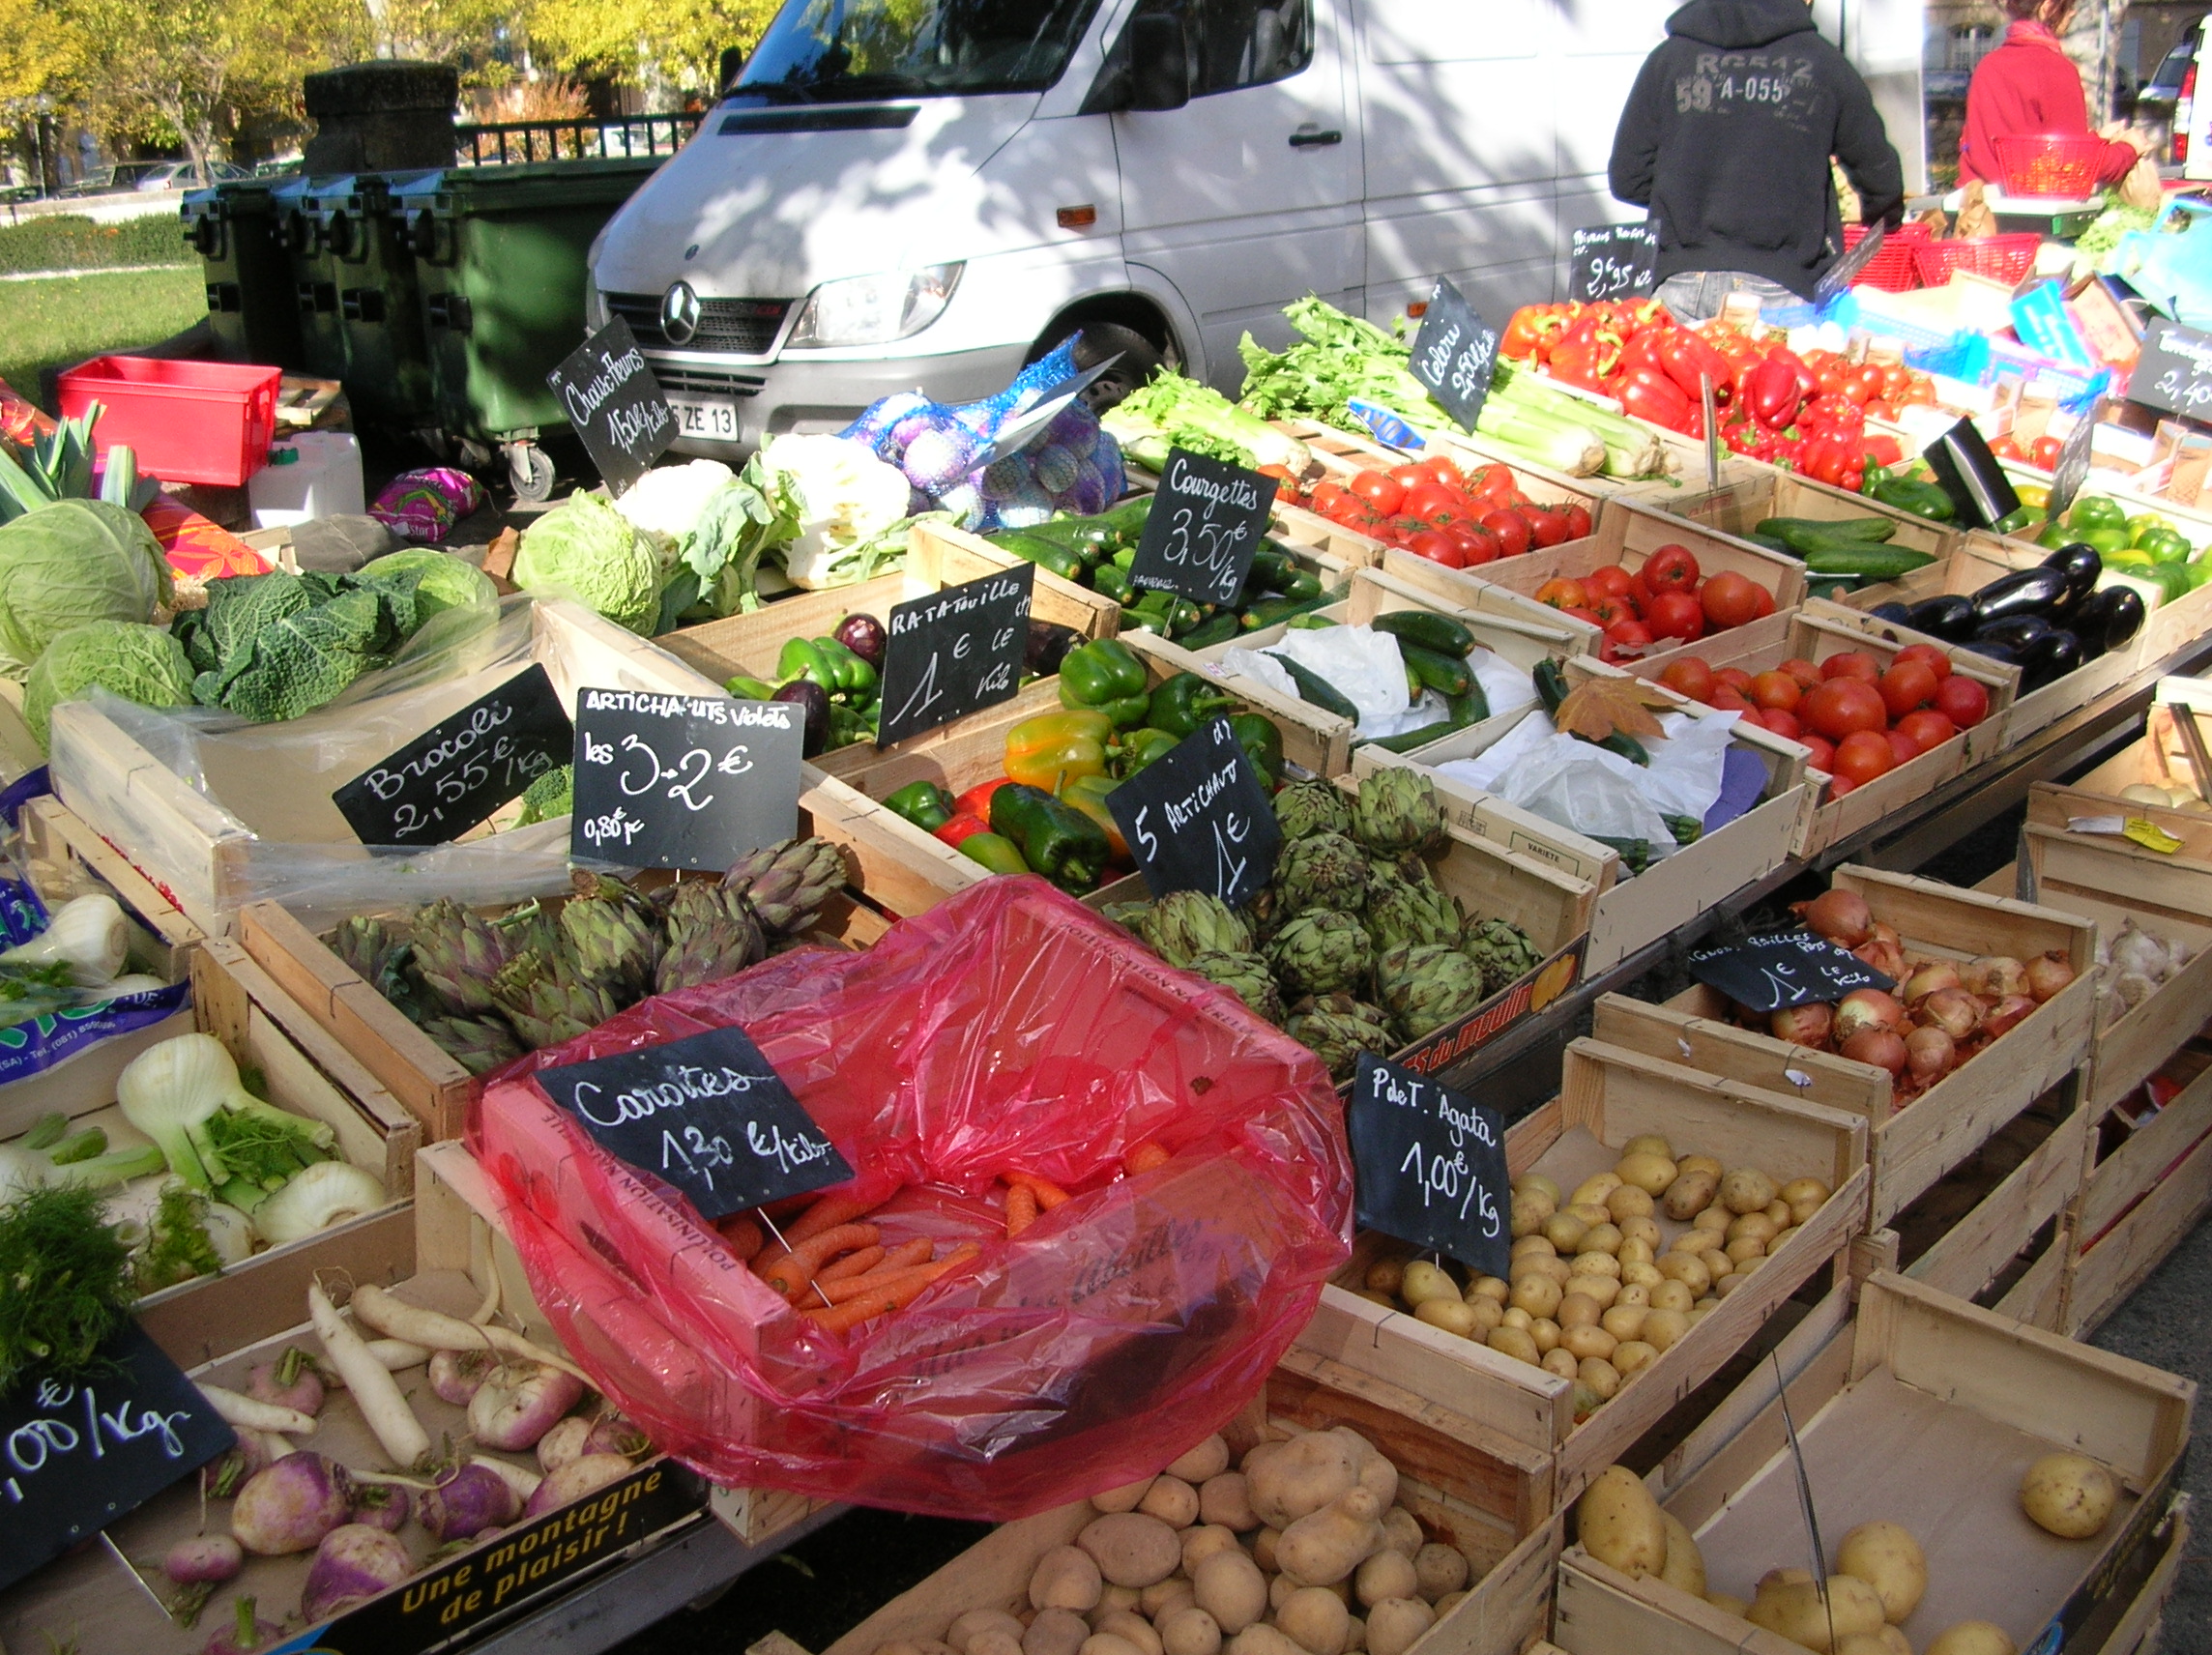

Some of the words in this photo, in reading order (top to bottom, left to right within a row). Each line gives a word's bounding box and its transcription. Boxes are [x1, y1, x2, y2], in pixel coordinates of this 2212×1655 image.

[684, 406, 705, 431] ZE
[712, 408, 732, 433] 13
[1171, 458, 1258, 520] Courgettes
[364, 700, 513, 800] Brocoli
[620, 734, 660, 796] 3
[668, 748, 714, 811] 2
[1135, 804, 1158, 863] 5
[1439, 1093, 1497, 1147] Agata
[402, 1563, 473, 1613] Une
[485, 1470, 662, 1575] montagne
[440, 1588, 482, 1625] de
[493, 1524, 610, 1605] plaisir
